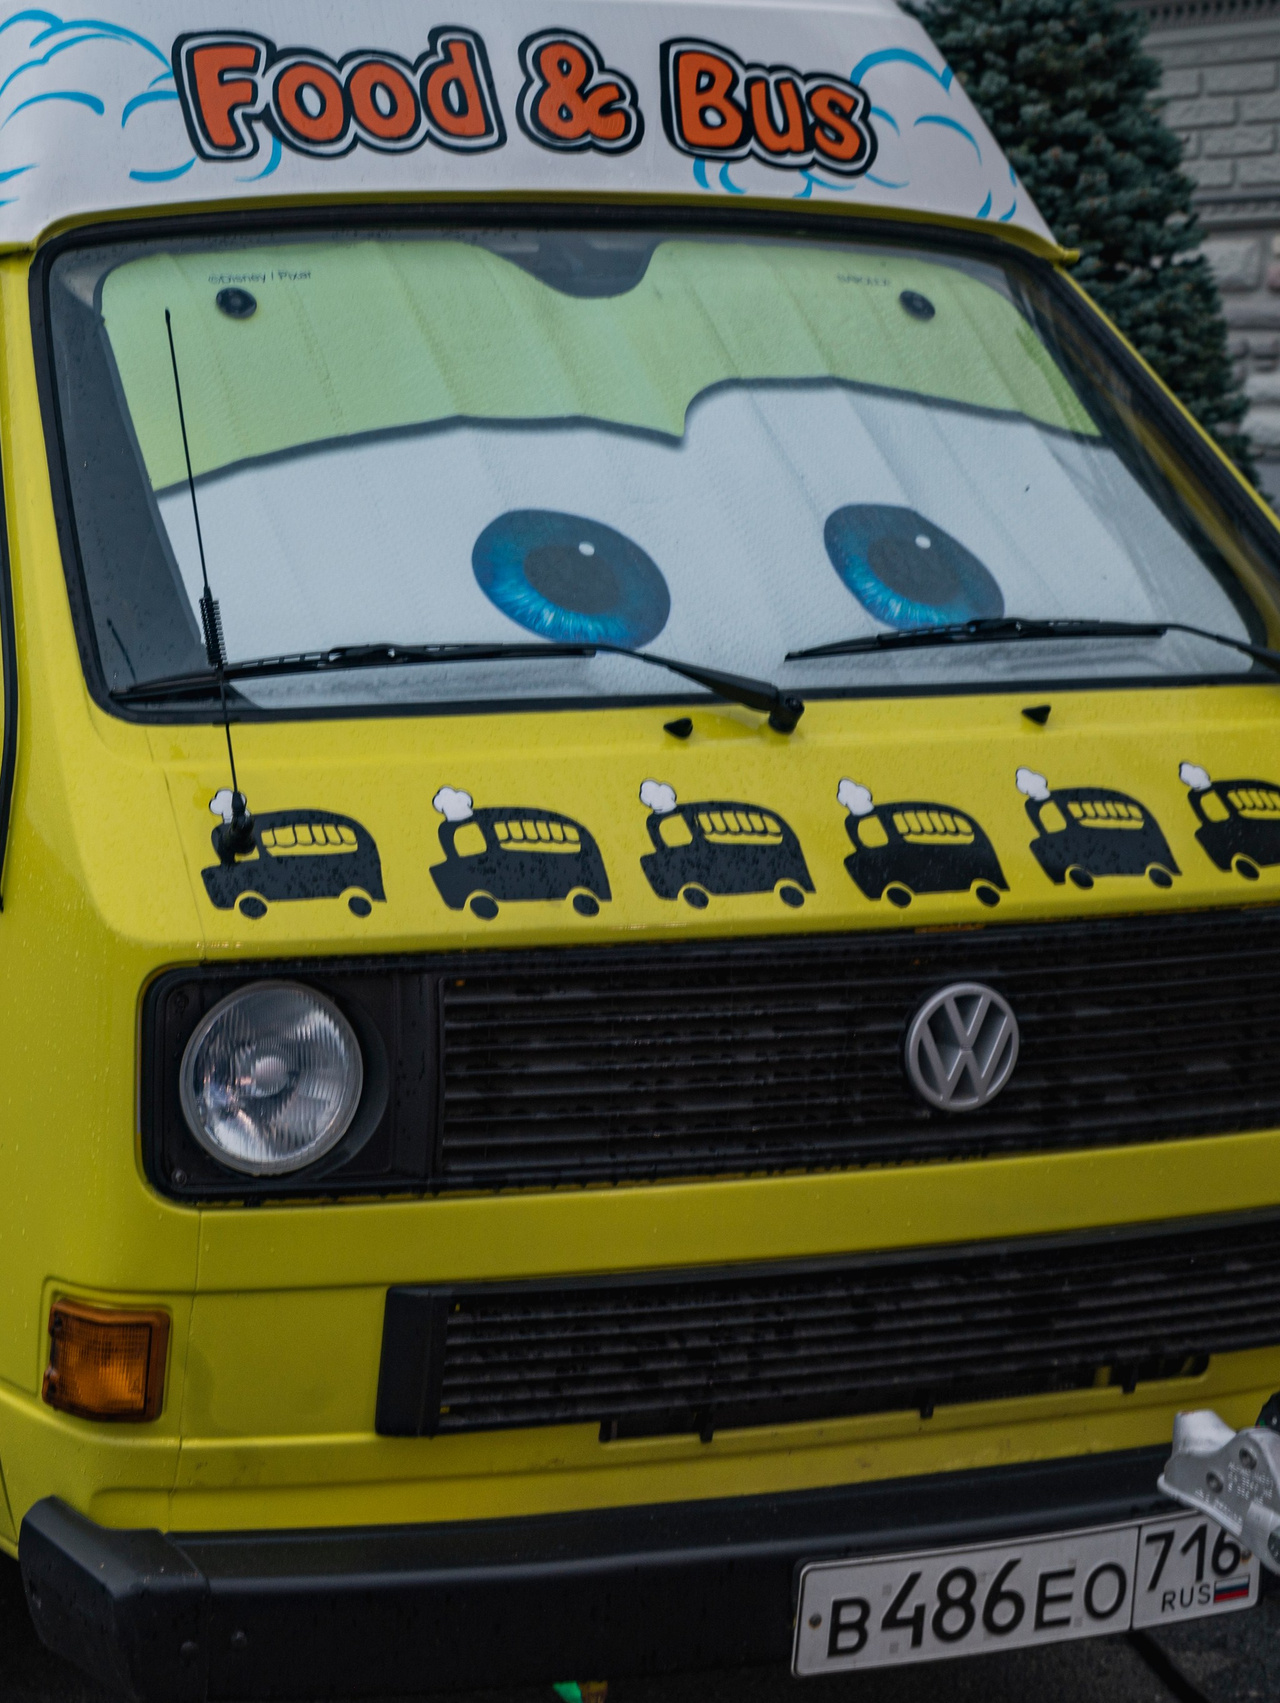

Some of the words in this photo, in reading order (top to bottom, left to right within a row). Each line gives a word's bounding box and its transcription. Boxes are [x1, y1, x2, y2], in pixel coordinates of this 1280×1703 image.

[180, 30, 498, 156] Food
[525, 33, 638, 148] &
[668, 42, 870, 171] Bus
[1145, 1523, 1241, 1592] 716
[1161, 1583, 1212, 1613] RUS
